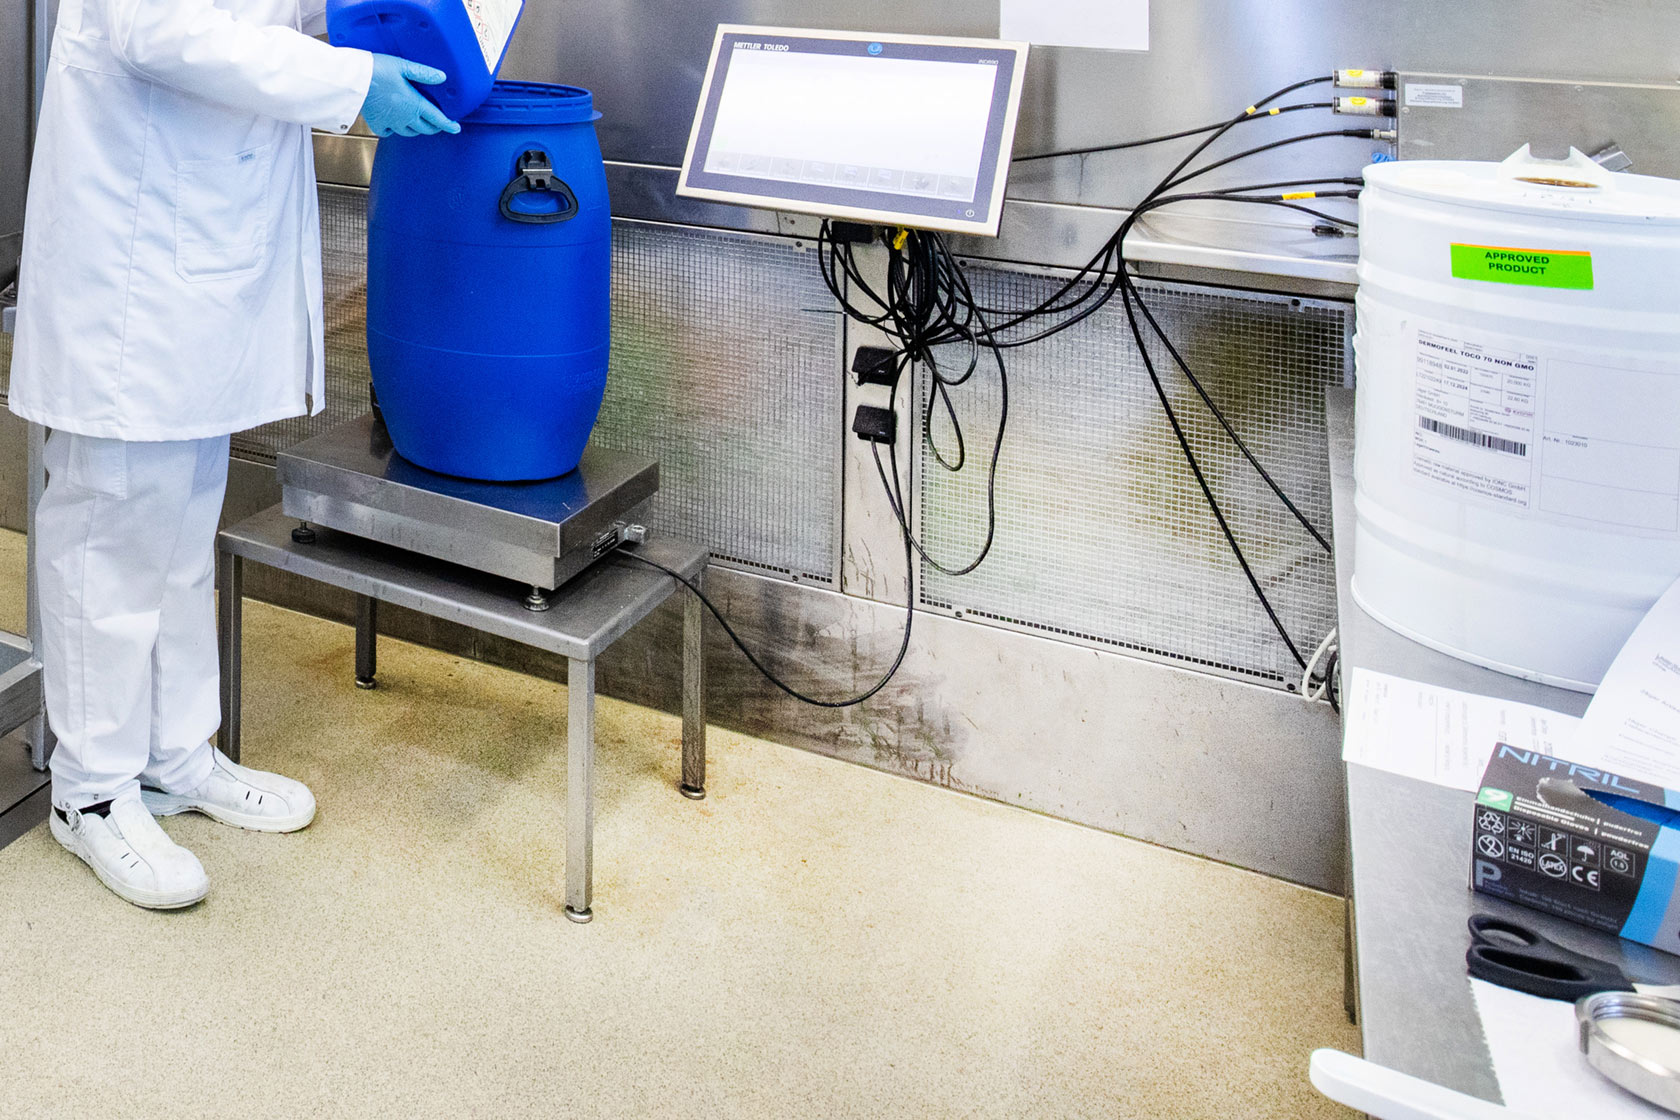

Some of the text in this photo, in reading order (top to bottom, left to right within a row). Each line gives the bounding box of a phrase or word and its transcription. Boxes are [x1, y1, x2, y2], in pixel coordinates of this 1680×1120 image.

[733, 41, 790, 52] METTLER TOLEDO
[1484, 251, 1550, 265] APPROVED
[1487, 262, 1547, 275] PRODUCT
[1418, 339, 1458, 355] DERMOFEEL
[1460, 350, 1481, 360] TOCO
[1494, 359, 1513, 367] NON
[1514, 362, 1534, 371] GMO
[1461, 470, 1484, 482] approved
[1486, 482, 1513, 495] COSMOS
[1498, 745, 1640, 794] NITRIL
[1513, 804, 1559, 823] Disposable
[1560, 818, 1590, 832] Gloves
[1601, 831, 1649, 850] powderfree
[1603, 821, 1643, 836] puderfrei
[1508, 846, 1535, 859] EN ISO
[1610, 849, 1630, 861] AQL
[1475, 859, 1502, 888] P
